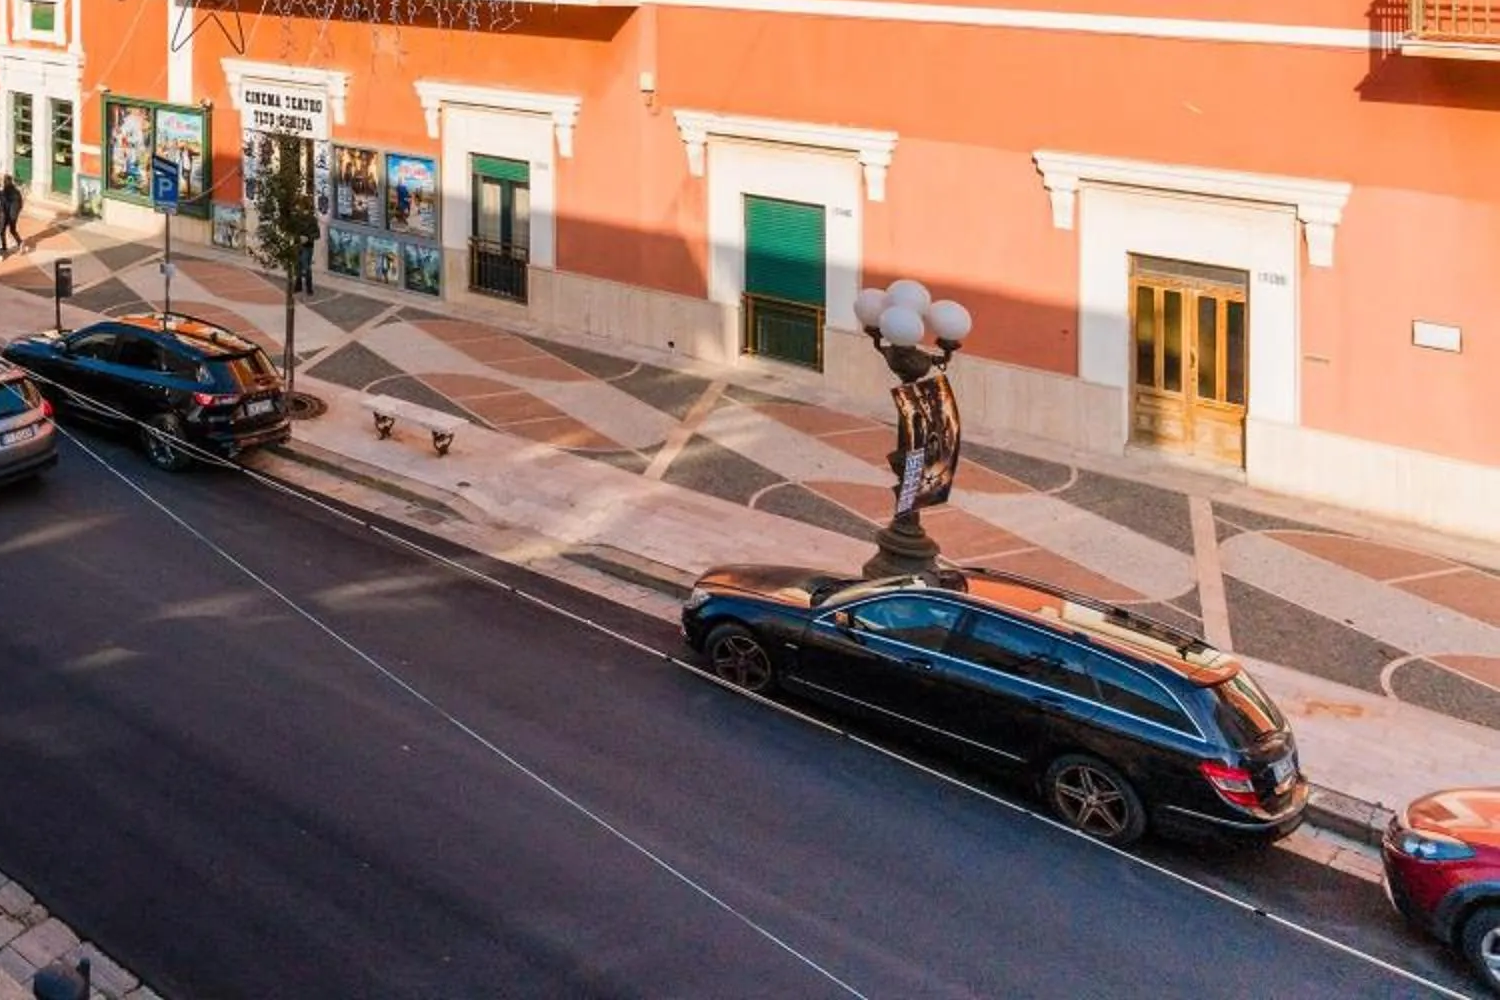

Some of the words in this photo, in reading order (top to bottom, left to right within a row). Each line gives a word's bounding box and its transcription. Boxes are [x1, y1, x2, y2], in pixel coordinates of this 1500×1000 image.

[246, 90, 281, 108] CINEMA
[285, 95, 323, 114] TEATRO
[157, 177, 173, 198] P
